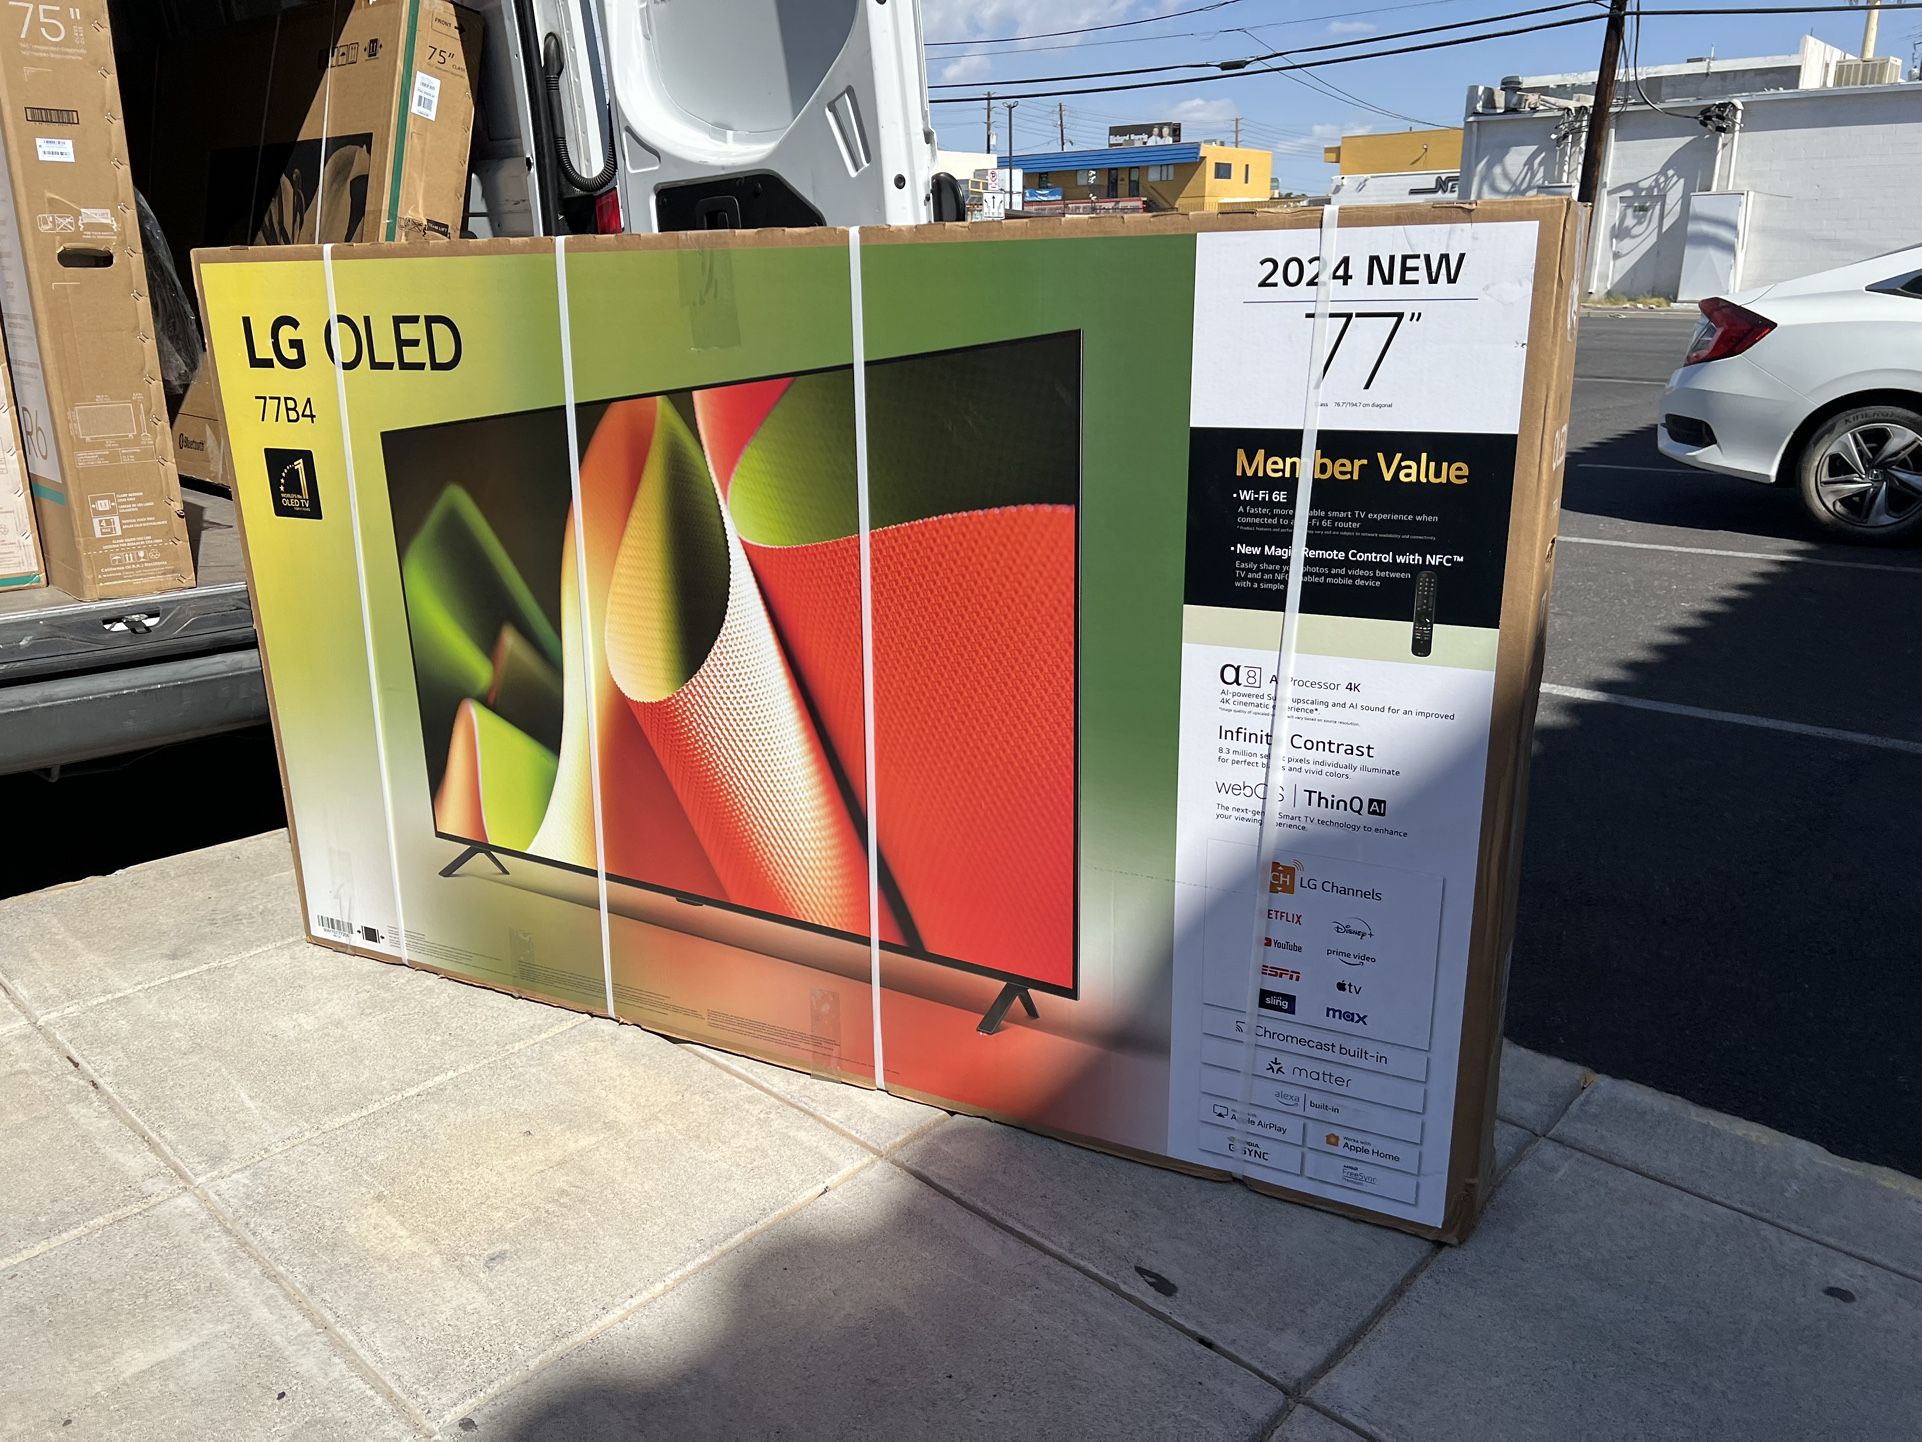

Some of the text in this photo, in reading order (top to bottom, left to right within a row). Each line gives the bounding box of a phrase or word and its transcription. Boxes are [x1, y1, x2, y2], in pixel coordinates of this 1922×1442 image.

[9, 1, 80, 42] 75"
[1257, 252, 1466, 287] 2024 NEW
[242, 314, 462, 371] LG OLED
[255, 396, 316, 423] 77B4
[21, 406, 48, 461] R6
[1377, 452, 1469, 484] Value
[281, 498, 309, 507] OLED TV
[1239, 489, 1287, 502] Wi-Fi 6E
[1237, 505, 1244, 513] A
[1246, 505, 1271, 515] faster,
[1327, 510, 1352, 518] smart
[1354, 510, 1366, 519] TV
[1367, 512, 1413, 521] experience
[1415, 514, 1439, 522] when
[1237, 516, 1278, 524] connected
[1321, 519, 1333, 527] 6E
[1334, 520, 1361, 529] router
[1236, 543, 1261, 555] New
[1264, 544, 1292, 559] Magi
[1303, 547, 1345, 560] Remote
[1348, 549, 1393, 563] Control
[1396, 552, 1422, 564] with
[1235, 560, 1258, 570] Easily
[1330, 567, 1346, 575] and
[1347, 568, 1374, 577] videos
[1376, 569, 1411, 579] between
[1235, 570, 1246, 578] TV
[1247, 571, 1262, 579] and
[1326, 577, 1353, 585] mobile
[1354, 578, 1381, 587] device
[1234, 580, 1251, 588] with
[1259, 581, 1285, 591] simple
[1345, 682, 1361, 693] 4K
[1219, 697, 1231, 705] 4K
[1232, 698, 1270, 709] cinematic
[1220, 688, 1265, 700] AI-powered
[1291, 697, 1329, 708] upscaling
[1331, 701, 1347, 709] and
[1348, 702, 1358, 710] AI
[1360, 704, 1386, 713] sound
[1387, 706, 1401, 714] for
[1402, 708, 1413, 716] an
[1415, 709, 1455, 721] improved
[1219, 725, 1375, 758] Infinit Contrast
[1217, 755, 1229, 763] for
[1231, 758, 1259, 768] perfect
[1287, 765, 1302, 773] and
[1304, 767, 1323, 776] vivid
[1324, 770, 1352, 780] colors.
[1218, 746, 1231, 755] 8.3
[1232, 749, 1258, 758] million
[1287, 756, 1310, 765] pixels
[1312, 758, 1358, 772] individually
[1359, 764, 1400, 777] illuminate
[1304, 789, 1363, 816] ThinQ
[1368, 799, 1386, 816] AI
[1216, 812, 1232, 820] your
[1234, 815, 1263, 827] viewing
[1216, 803, 1408, 838] The next-gen Smart TV technology to enhance
[1271, 872, 1290, 885] CH
[1299, 876, 1382, 901] LG Channels
[1267, 908, 1302, 926] ETFLIX
[1332, 917, 1374, 940] Disney+
[1273, 939, 1302, 953] YouTube
[1326, 948, 1377, 963] prime video
[1261, 964, 1301, 982] ESPN
[1265, 996, 1289, 1010] sling
[1326, 1006, 1368, 1026] max
[1255, 1025, 1388, 1066] Chromecast built-in
[1292, 1065, 1353, 1088] matter
[1274, 1090, 1340, 1114] alexa built-in
[1257, 1119, 1288, 1135] AirPlay
[1343, 1141, 1400, 1162] Apple Home
